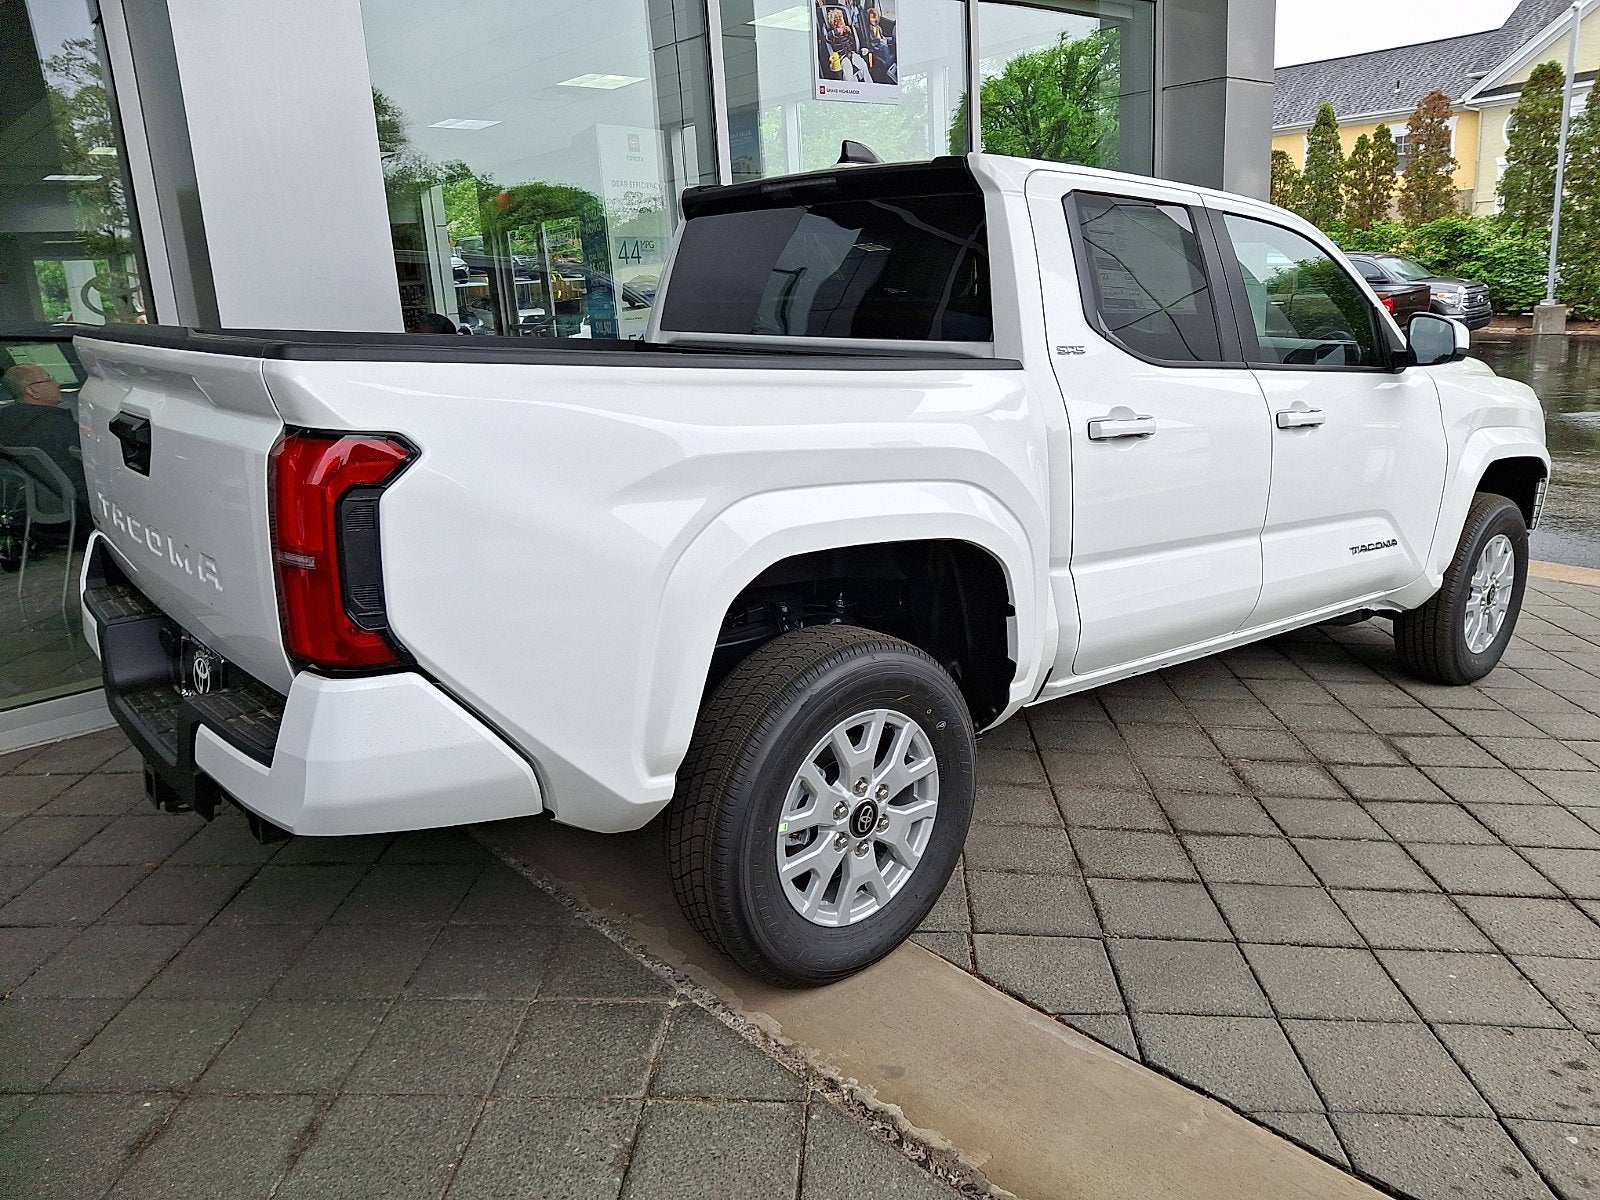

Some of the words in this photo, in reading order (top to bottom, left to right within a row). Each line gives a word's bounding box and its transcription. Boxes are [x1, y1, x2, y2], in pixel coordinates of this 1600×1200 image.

[626, 154, 645, 163] TOYOTA
[618, 240, 642, 265] 44
[640, 240, 655, 249] MPG
[1056, 345, 1087, 356] SR5
[97, 491, 225, 593] TACOMA
[1348, 538, 1398, 555] TACOMA
